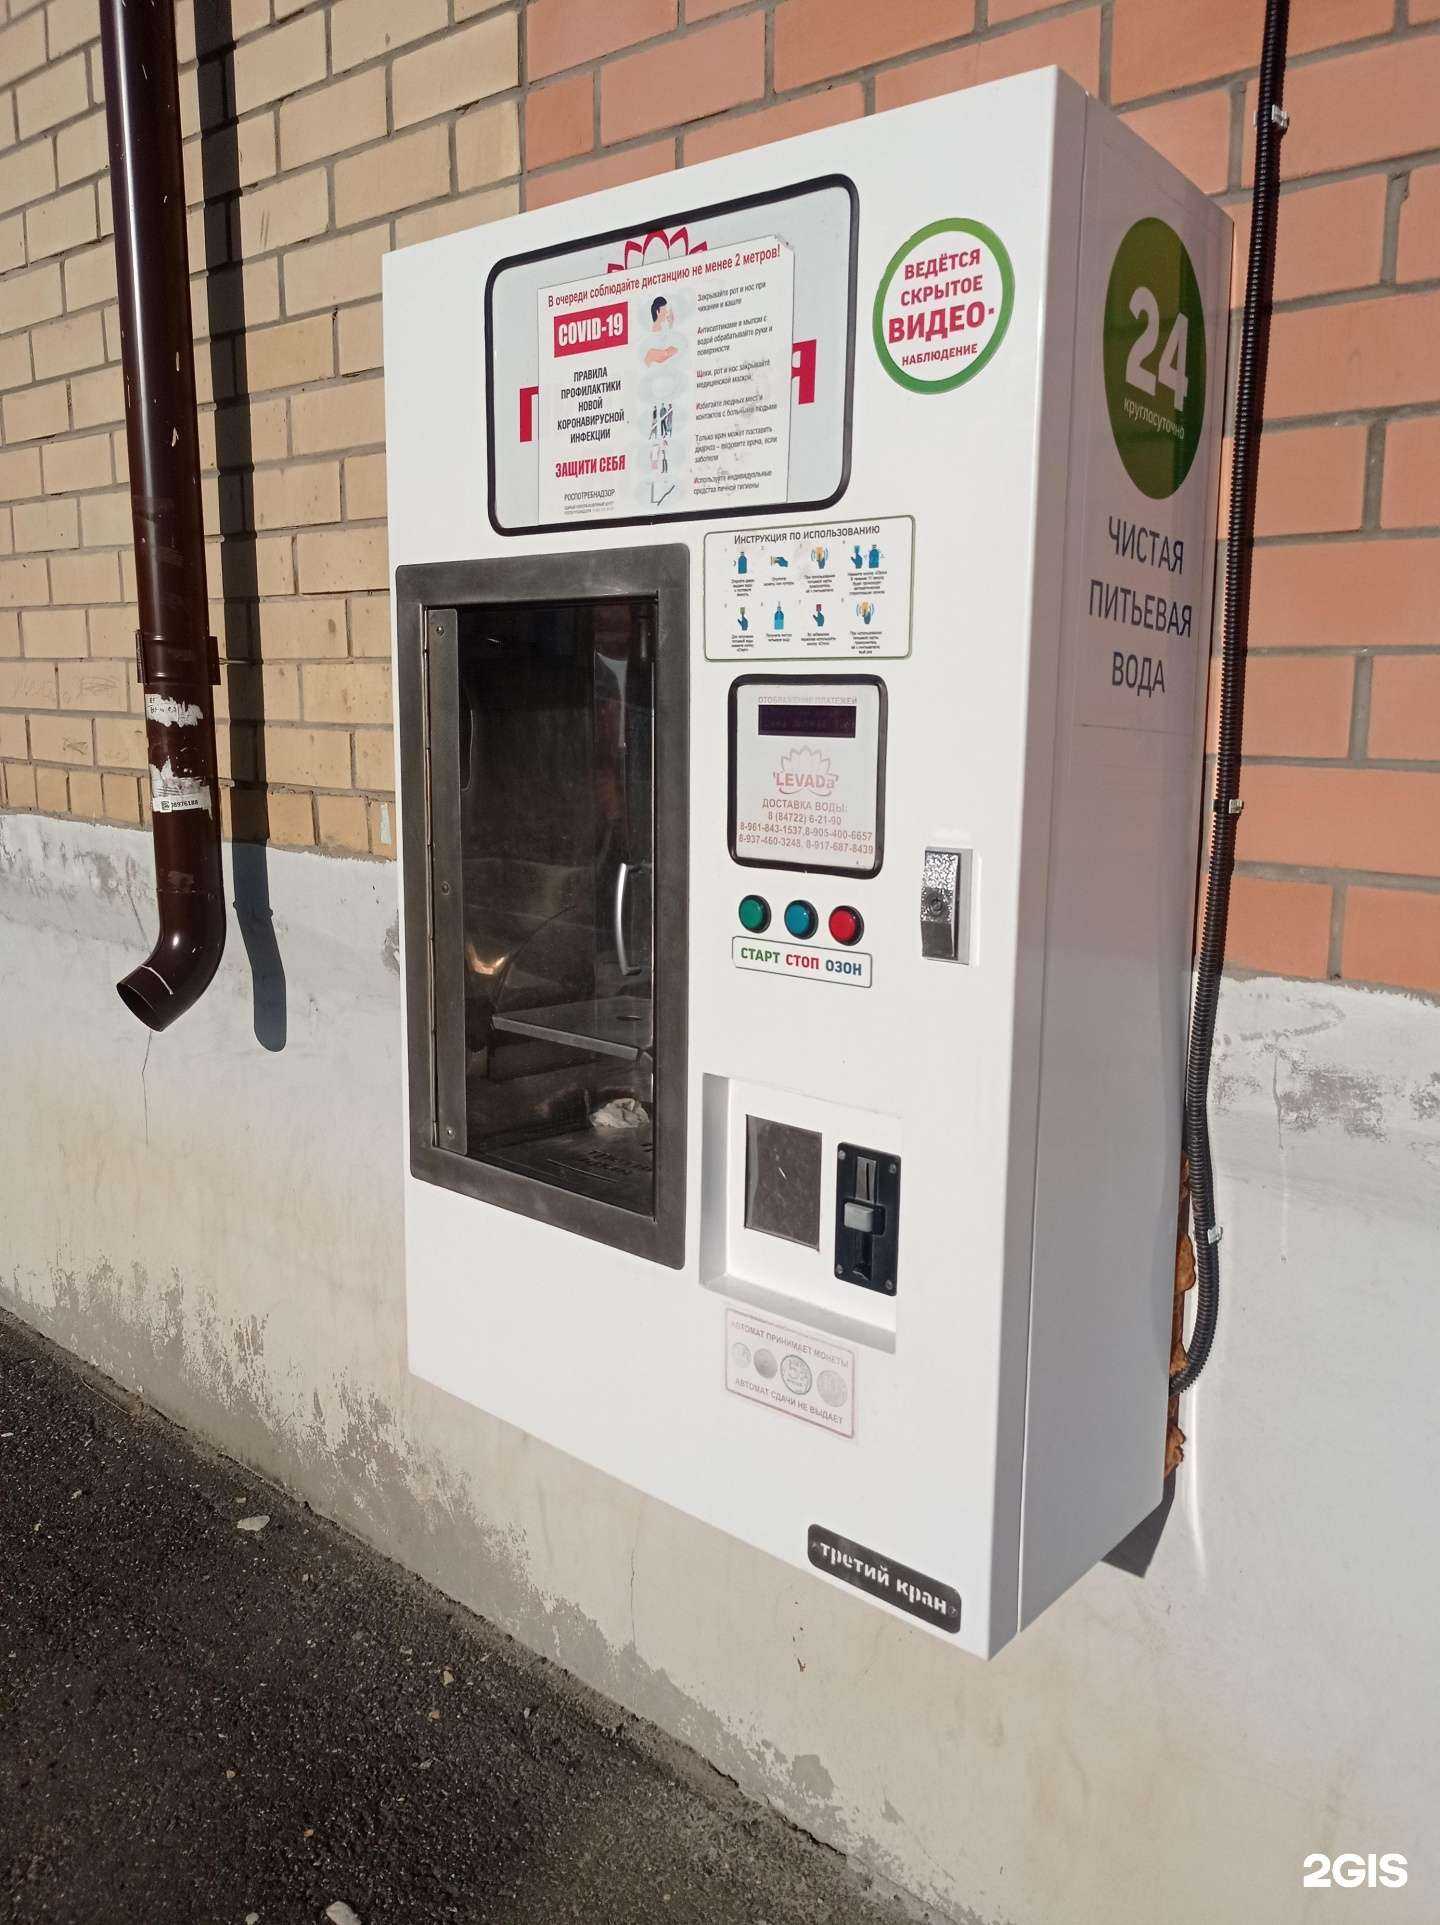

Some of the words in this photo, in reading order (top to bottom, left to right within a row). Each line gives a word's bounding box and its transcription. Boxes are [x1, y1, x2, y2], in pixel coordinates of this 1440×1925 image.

[548, 294, 554, 308] В
[555, 288, 588, 307] очереди
[590, 278, 640, 299] соблюдайте
[642, 265, 690, 290] дистанцию
[691, 264, 703, 277] не
[705, 258, 733, 273] менее
[735, 252, 741, 267] 2
[742, 244, 781, 265] метров!
[905, 248, 981, 280] ВЕДЁТСЯ
[697, 290, 729, 302] Закрывайте
[729, 287, 739, 297] рот
[745, 283, 755, 292] нос
[755, 282, 766, 290] при
[725, 298, 742, 308] кашле
[900, 275, 983, 306] СКРЫТОЕ
[558, 312, 624, 347] COVID-19
[755, 327, 768, 337] руки
[888, 301, 994, 344] ВИДЕО-
[902, 343, 978, 366] НАБЛЮДЕНИЕ
[1125, 285, 1189, 412] 24
[573, 366, 608, 383] ПРАВИЛА
[713, 368, 723, 377] рот
[728, 365, 738, 373] нос
[561, 380, 621, 400] ПРОФИЛАКТИКИ
[578, 396, 603, 412] НОВОЙ
[557, 408, 625, 431] КОРОНАВИРУСНОЙ
[1123, 397, 1185, 440] круглосуточно
[570, 427, 611, 444] ИНФЕКЦИИ
[555, 459, 597, 479] ЗАЩИТИ
[599, 454, 626, 474] СЕБЯ
[564, 488, 616, 501] РОСПОТРЕБНАДЗОР
[1108, 515, 1184, 575] ЧИСТАЯ
[1089, 579, 1193, 638] ПИТЬЕВАЯ
[1112, 651, 1166, 698] ВОДА
[762, 799, 812, 811] ДОСТАВКА
[775, 811, 807, 824] (84722)
[809, 814, 842, 825] 6-21-90
[740, 947, 781, 964] СТАРТ
[785, 953, 820, 970] СТОП
[825, 959, 862, 976] ОЗОН
[766, 1332, 813, 1355] ПРИНИМАЕТ
[814, 1349, 849, 1368] МОНЕТЫ
[735, 1377, 769, 1396] АВТОМАТ
[771, 1390, 796, 1407] СДАЧИ
[797, 1401, 808, 1412] НЕ
[809, 1406, 843, 1425] ВЫДАЕТ
[820, 1542, 890, 1587] третий
[896, 1578, 947, 1615] кран
